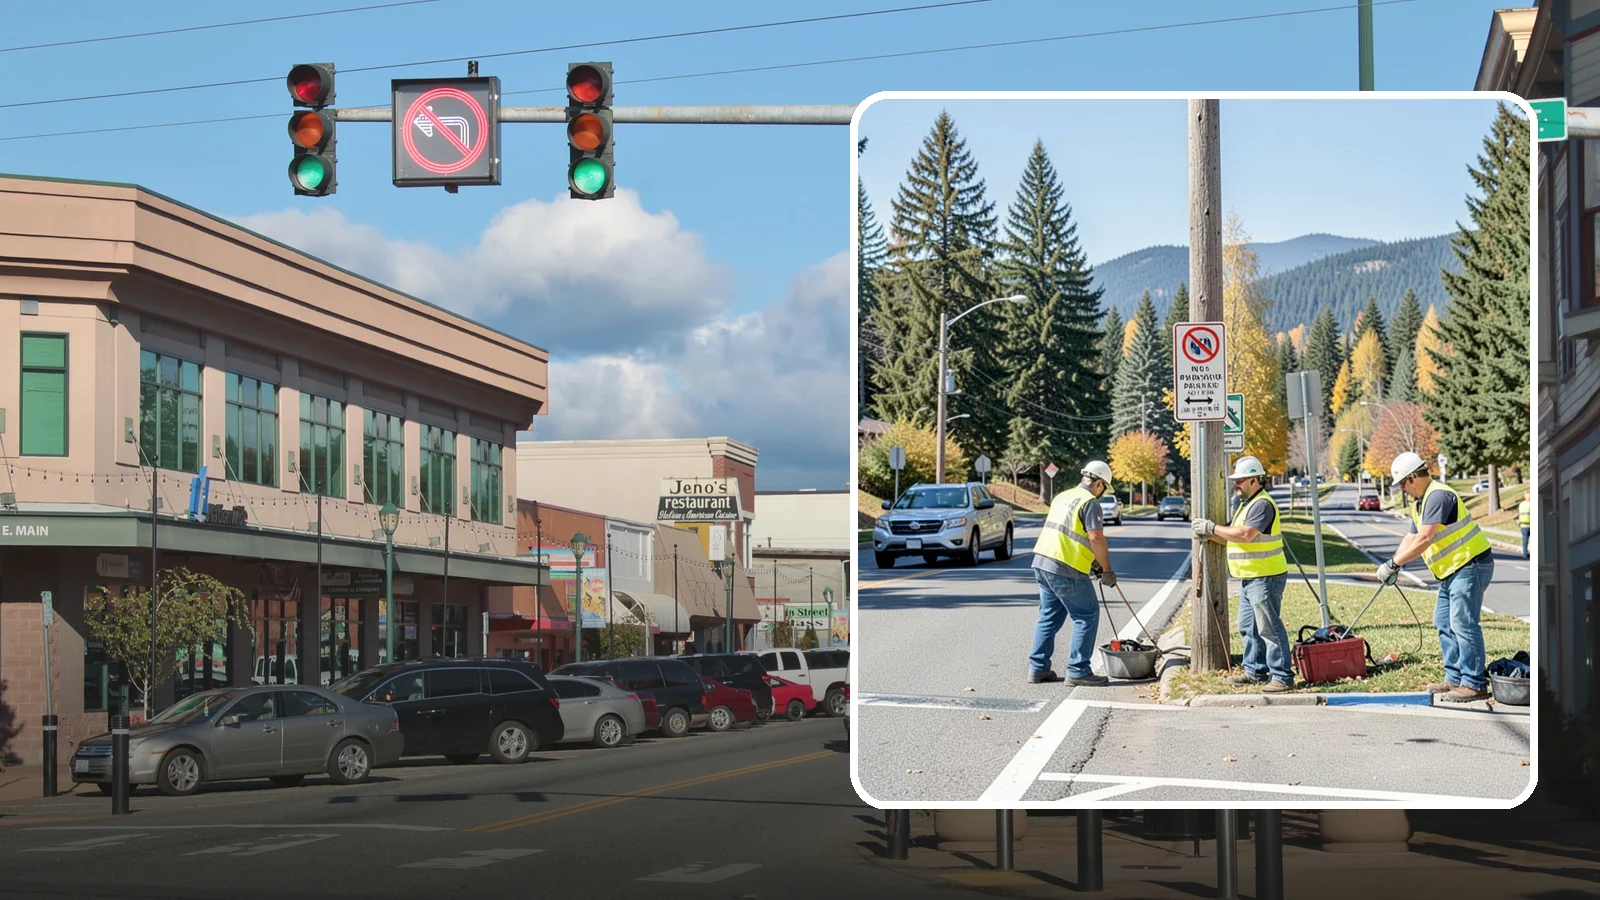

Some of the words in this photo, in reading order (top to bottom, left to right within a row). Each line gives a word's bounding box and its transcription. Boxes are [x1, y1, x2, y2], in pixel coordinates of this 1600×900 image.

[670, 480, 727, 494] Jeno's
[665, 496, 731, 509] restaurant
[659, 510, 682, 520] Italian
[686, 509, 714, 520] American
[715, 509, 737, 519] Cuisine
[2, 525, 13, 536] E.
[15, 525, 49, 536] MAIN
[797, 607, 828, 616] Street
